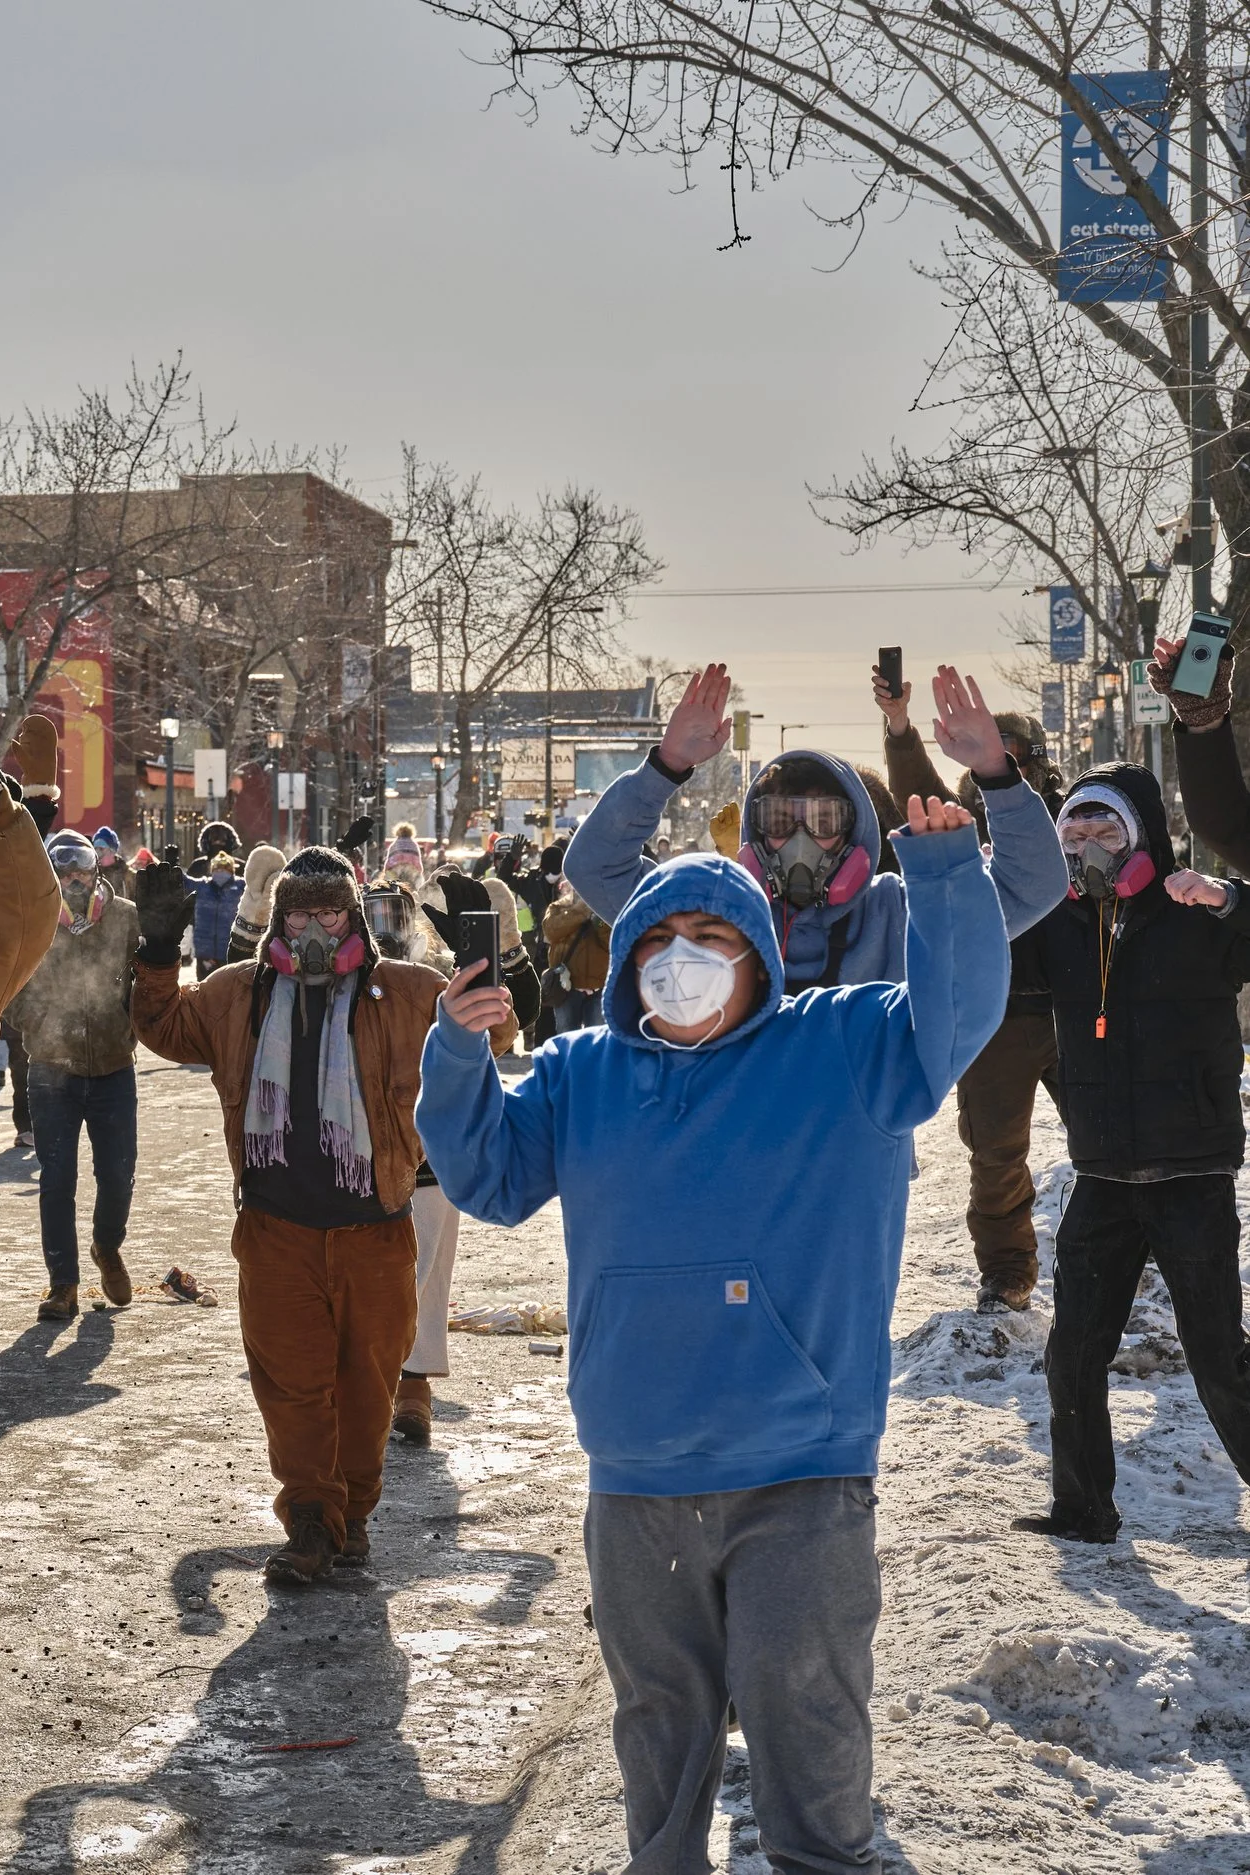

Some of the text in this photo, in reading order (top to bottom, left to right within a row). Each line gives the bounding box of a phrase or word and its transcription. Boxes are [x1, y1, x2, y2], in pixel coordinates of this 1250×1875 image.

[1070, 222, 1158, 236] eat street
[503, 755, 572, 764] MARHBA
